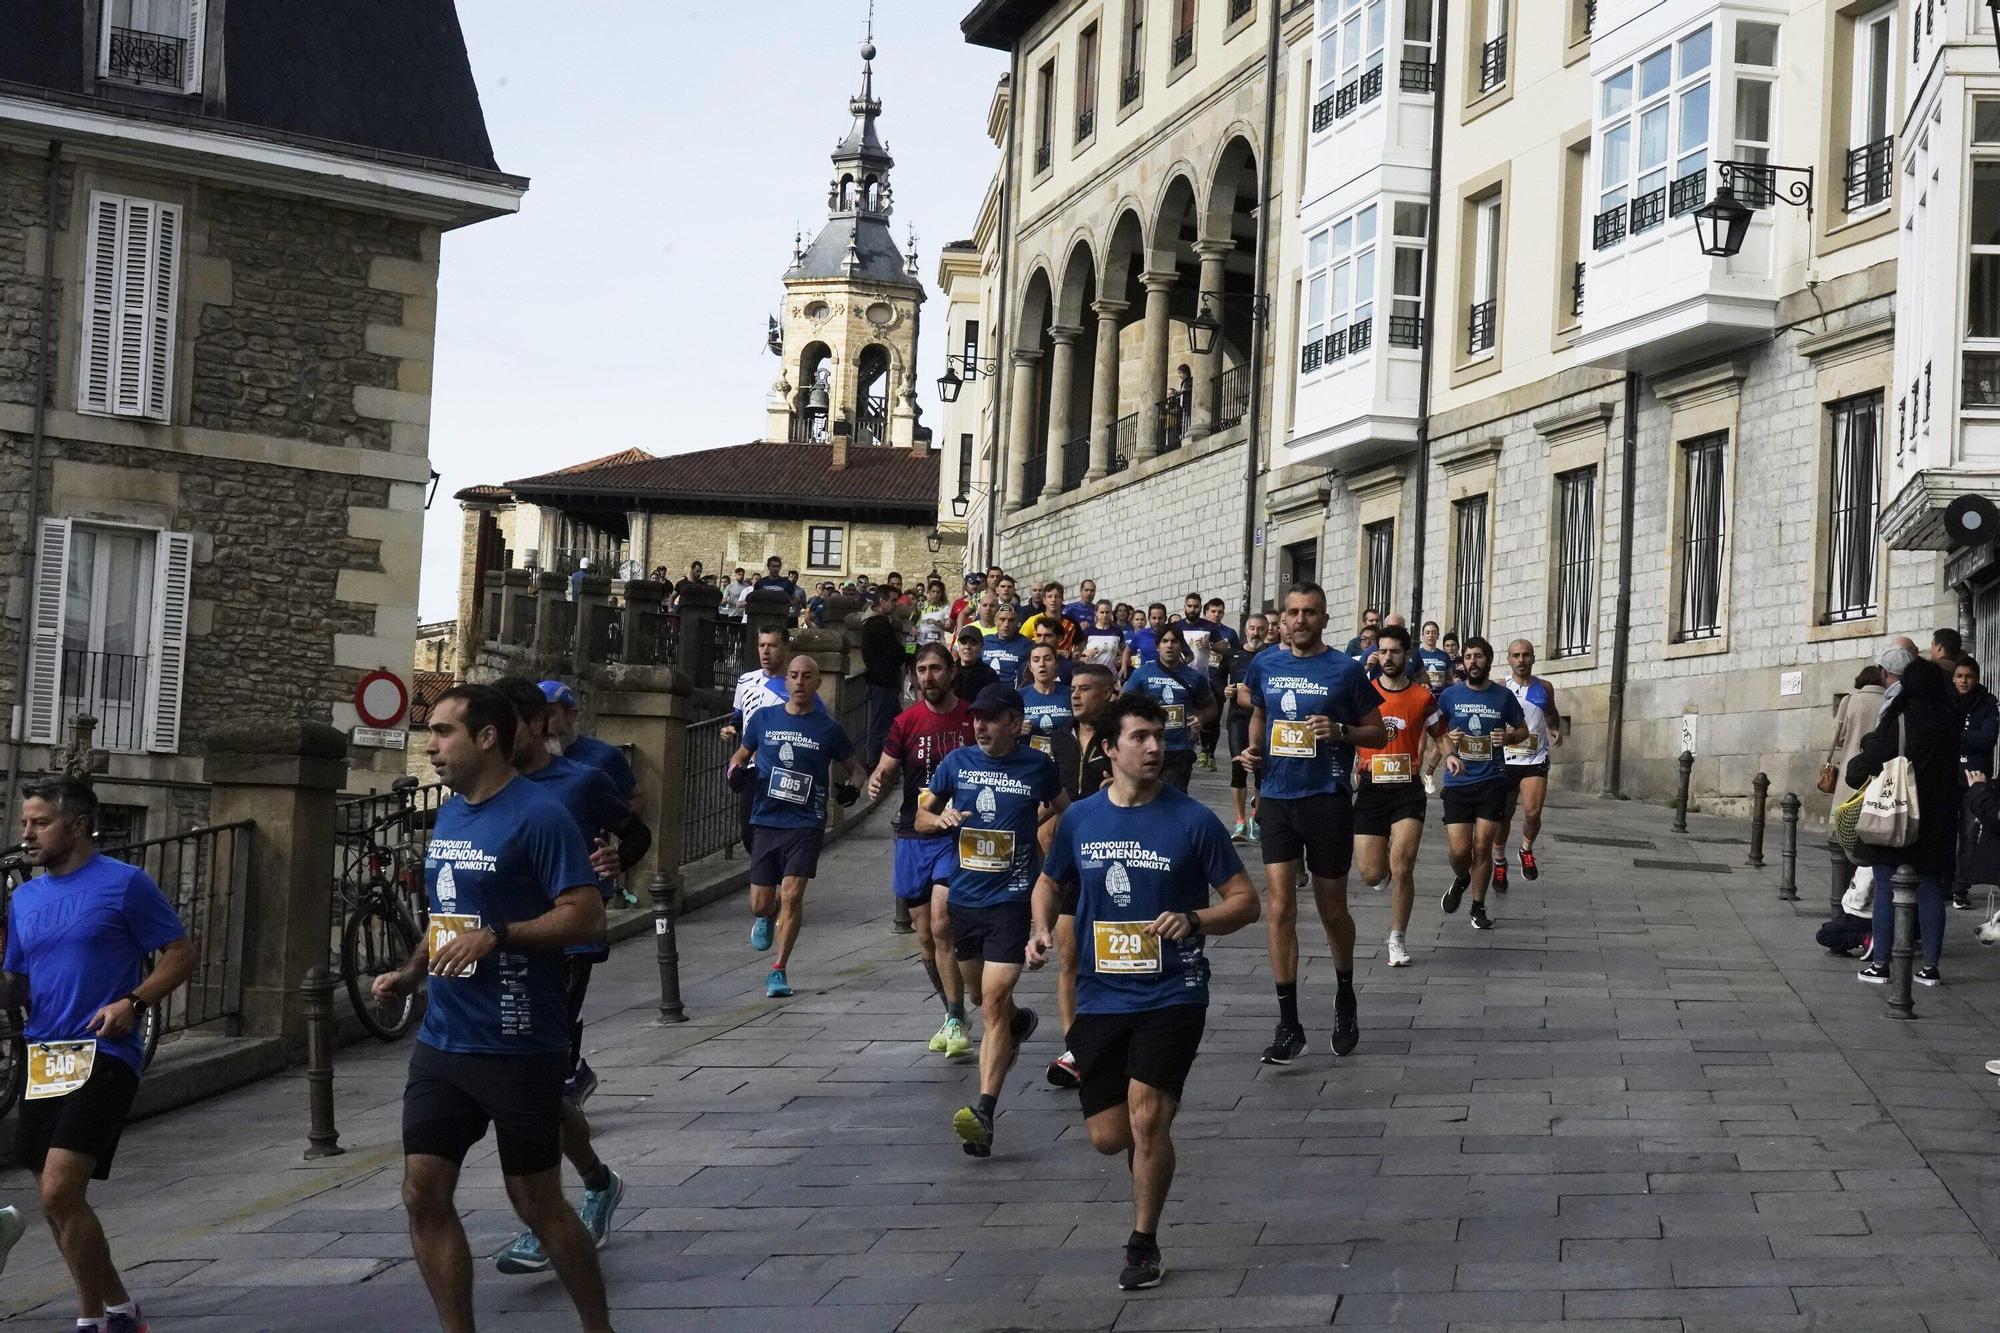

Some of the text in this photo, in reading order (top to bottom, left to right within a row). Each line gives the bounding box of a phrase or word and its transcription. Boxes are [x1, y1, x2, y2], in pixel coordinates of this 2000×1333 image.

[772, 734, 813, 744] ALMENDRA
[1281, 729, 1303, 743] 562
[1382, 761, 1401, 772] 702
[968, 770, 1008, 779] CONQUISTA
[780, 776, 801, 791] 885
[967, 776, 1022, 788] ALMENDRA
[995, 786, 1031, 797] KONKISTA
[433, 839, 472, 849] CONQUISTA
[976, 839, 995, 856] 90
[1090, 841, 1141, 850] CONQUISTA
[429, 848, 483, 861] ALMENDRA
[1091, 849, 1158, 861] ALMENDRA
[454, 860, 496, 872] KONKISTA
[1126, 859, 1171, 872] KONKISTA
[23, 888, 88, 942] RUN
[1109, 934, 1142, 954] 229
[45, 1054, 76, 1077] 546
